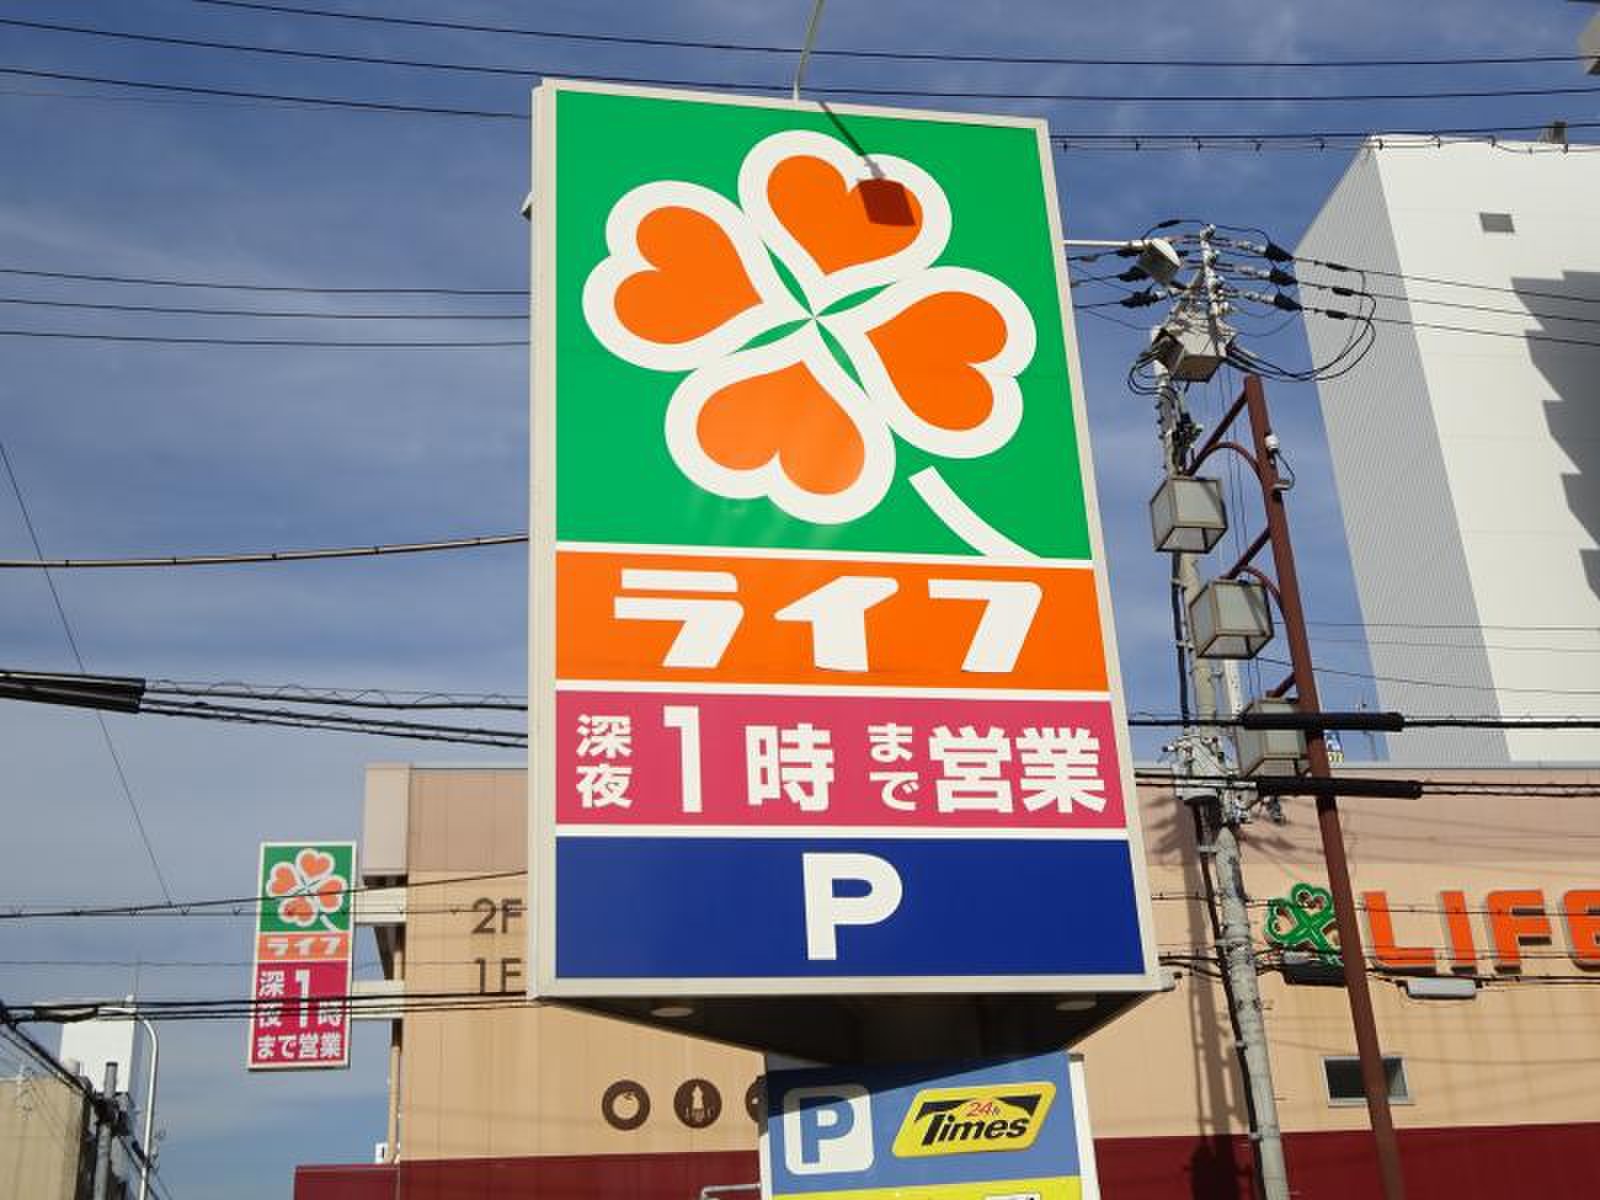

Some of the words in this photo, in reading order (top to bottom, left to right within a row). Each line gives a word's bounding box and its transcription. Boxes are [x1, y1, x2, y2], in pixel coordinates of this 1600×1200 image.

[613, 568, 1043, 673] ライフ
[471, 897, 523, 934] 2F
[802, 853, 903, 960] P
[267, 936, 342, 956] ライフ
[475, 958, 523, 993] 1F
[801, 1095, 855, 1164] P
[921, 1113, 1031, 1146] Times
